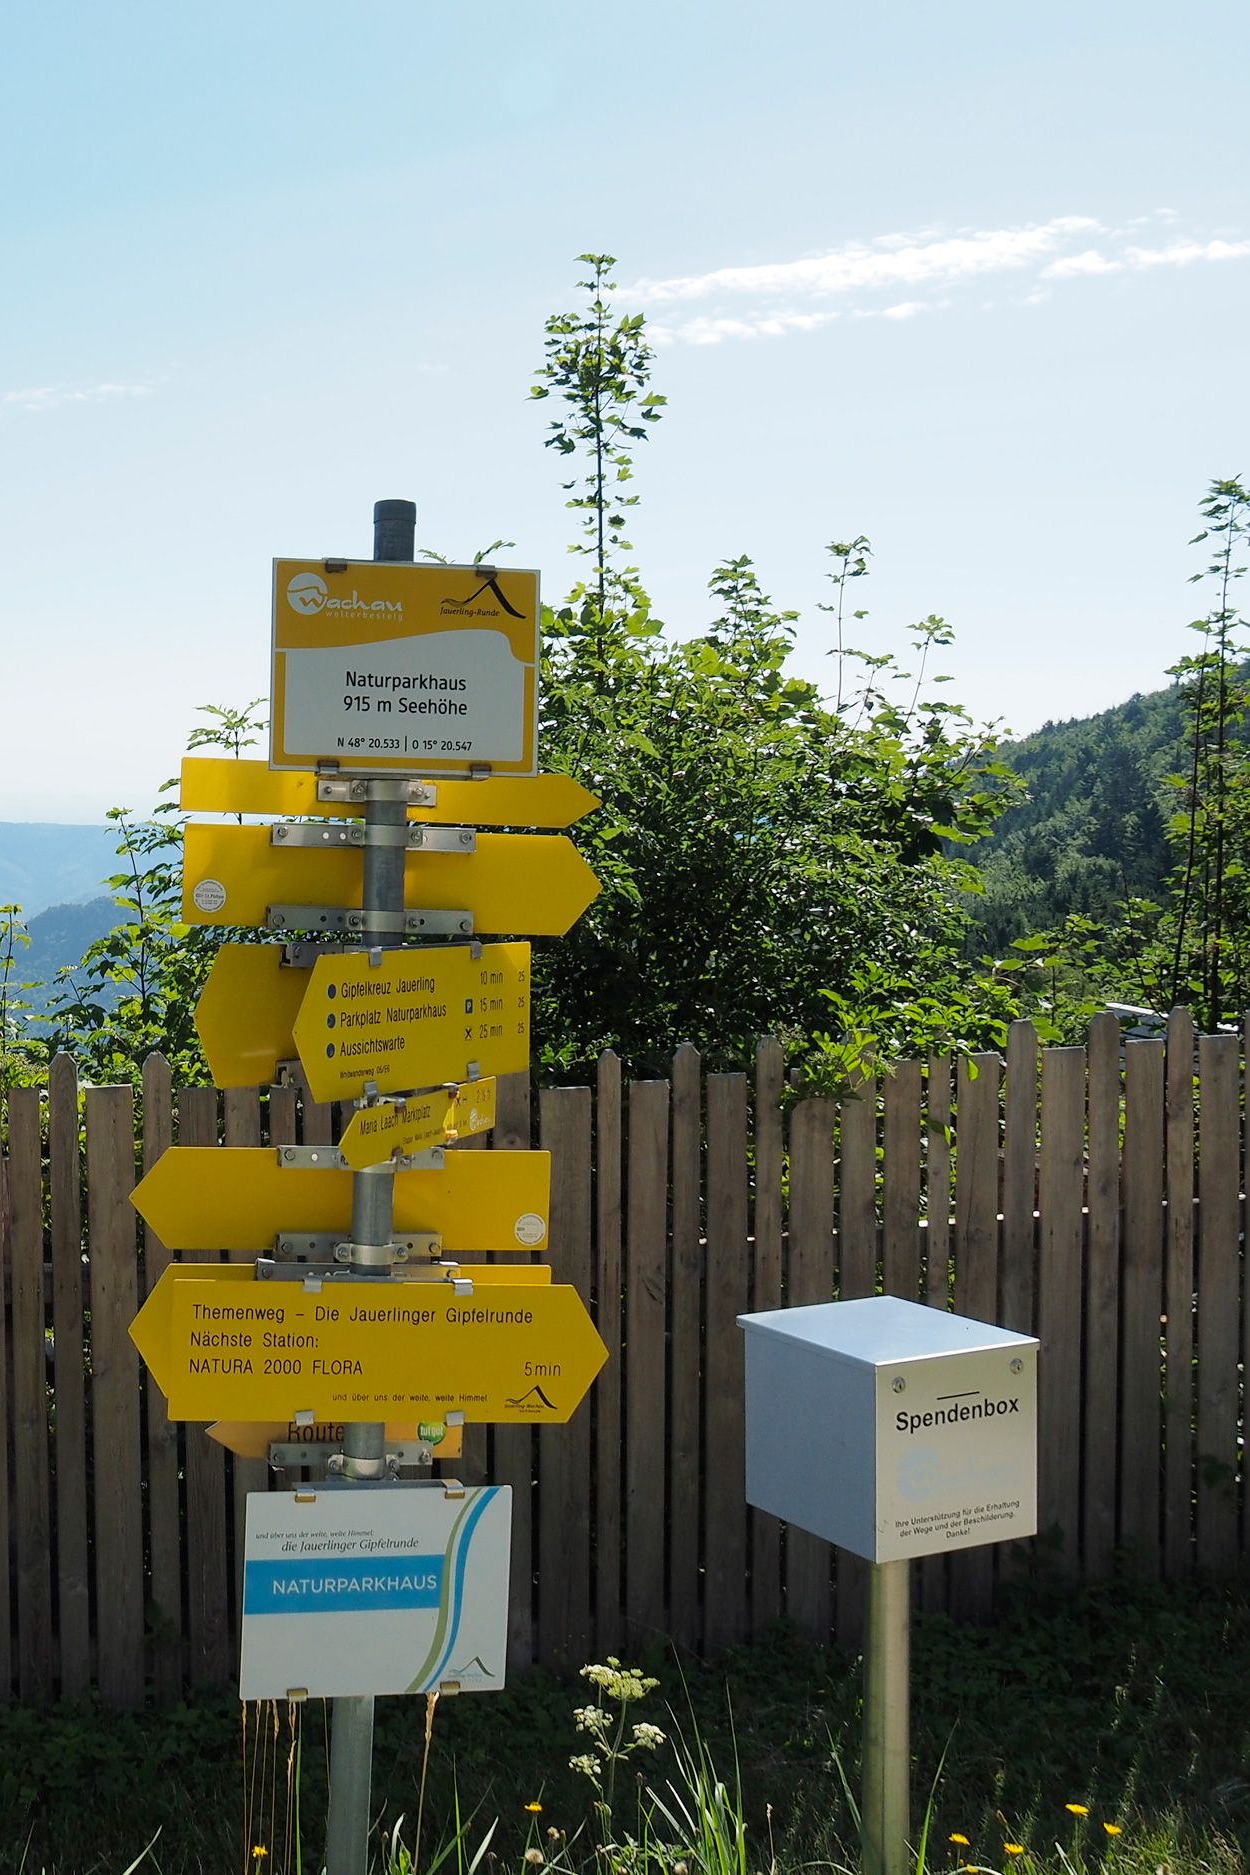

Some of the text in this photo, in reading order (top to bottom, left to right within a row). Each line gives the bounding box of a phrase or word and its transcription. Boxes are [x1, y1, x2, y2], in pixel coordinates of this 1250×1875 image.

[296, 590, 403, 614] Wachau
[440, 606, 500, 618] Jauerling-Runde
[345, 671, 467, 691] Naturparkhaus
[343, 695, 468, 715] 915 m Seehöhe
[337, 737, 344, 747] N
[347, 737, 365, 747] 48°
[368, 738, 400, 749] 20.533
[422, 740, 438, 750] 15°
[441, 740, 472, 751] 20.547
[341, 981, 391, 1000] Gipfelkreuz
[396, 976, 435, 994] Jauerling
[480, 970, 487, 985] 10
[490, 972, 503, 985] min
[340, 1009, 381, 1029] Parkplatz
[386, 1004, 447, 1023] Naturparkhaus
[480, 997, 487, 1013] 15
[490, 998, 502, 1011] min
[340, 1036, 405, 1057] Aussichtswarte
[480, 1023, 488, 1039] 25
[490, 1024, 502, 1037] min
[360, 1104, 431, 1136] Maria Laach Marktplatz
[192, 1304, 285, 1324] Themenweg
[315, 1306, 339, 1321] Die
[350, 1306, 436, 1325] Jauerlinger
[446, 1307, 533, 1326] Gipfelrunde
[190, 1331, 320, 1348] Nächste Station:
[189, 1358, 253, 1374] NATURA
[263, 1359, 302, 1375] 2000
[312, 1359, 363, 1375] FLORA
[332, 1393, 347, 1401] und
[351, 1393, 369, 1401] über
[392, 1393, 405, 1401] der
[435, 1393, 455, 1402] weite
[459, 1393, 488, 1402] Himmel
[896, 1398, 1019, 1434] Spendenbox
[288, 1421, 344, 1441] Route
[895, 1500, 1020, 1528] Ihre Unterstützung für die Erhaltung
[270, 1531, 284, 1539] über
[899, 1529, 911, 1537] der
[913, 1525, 933, 1535] Wege
[934, 1522, 948, 1531] und
[950, 1520, 962, 1528] der
[945, 1527, 970, 1538] Danke!
[281, 1537, 419, 1553] die Jauerlinger Gipfelrunde
[273, 1575, 437, 1595] NATURPARKHAUS
